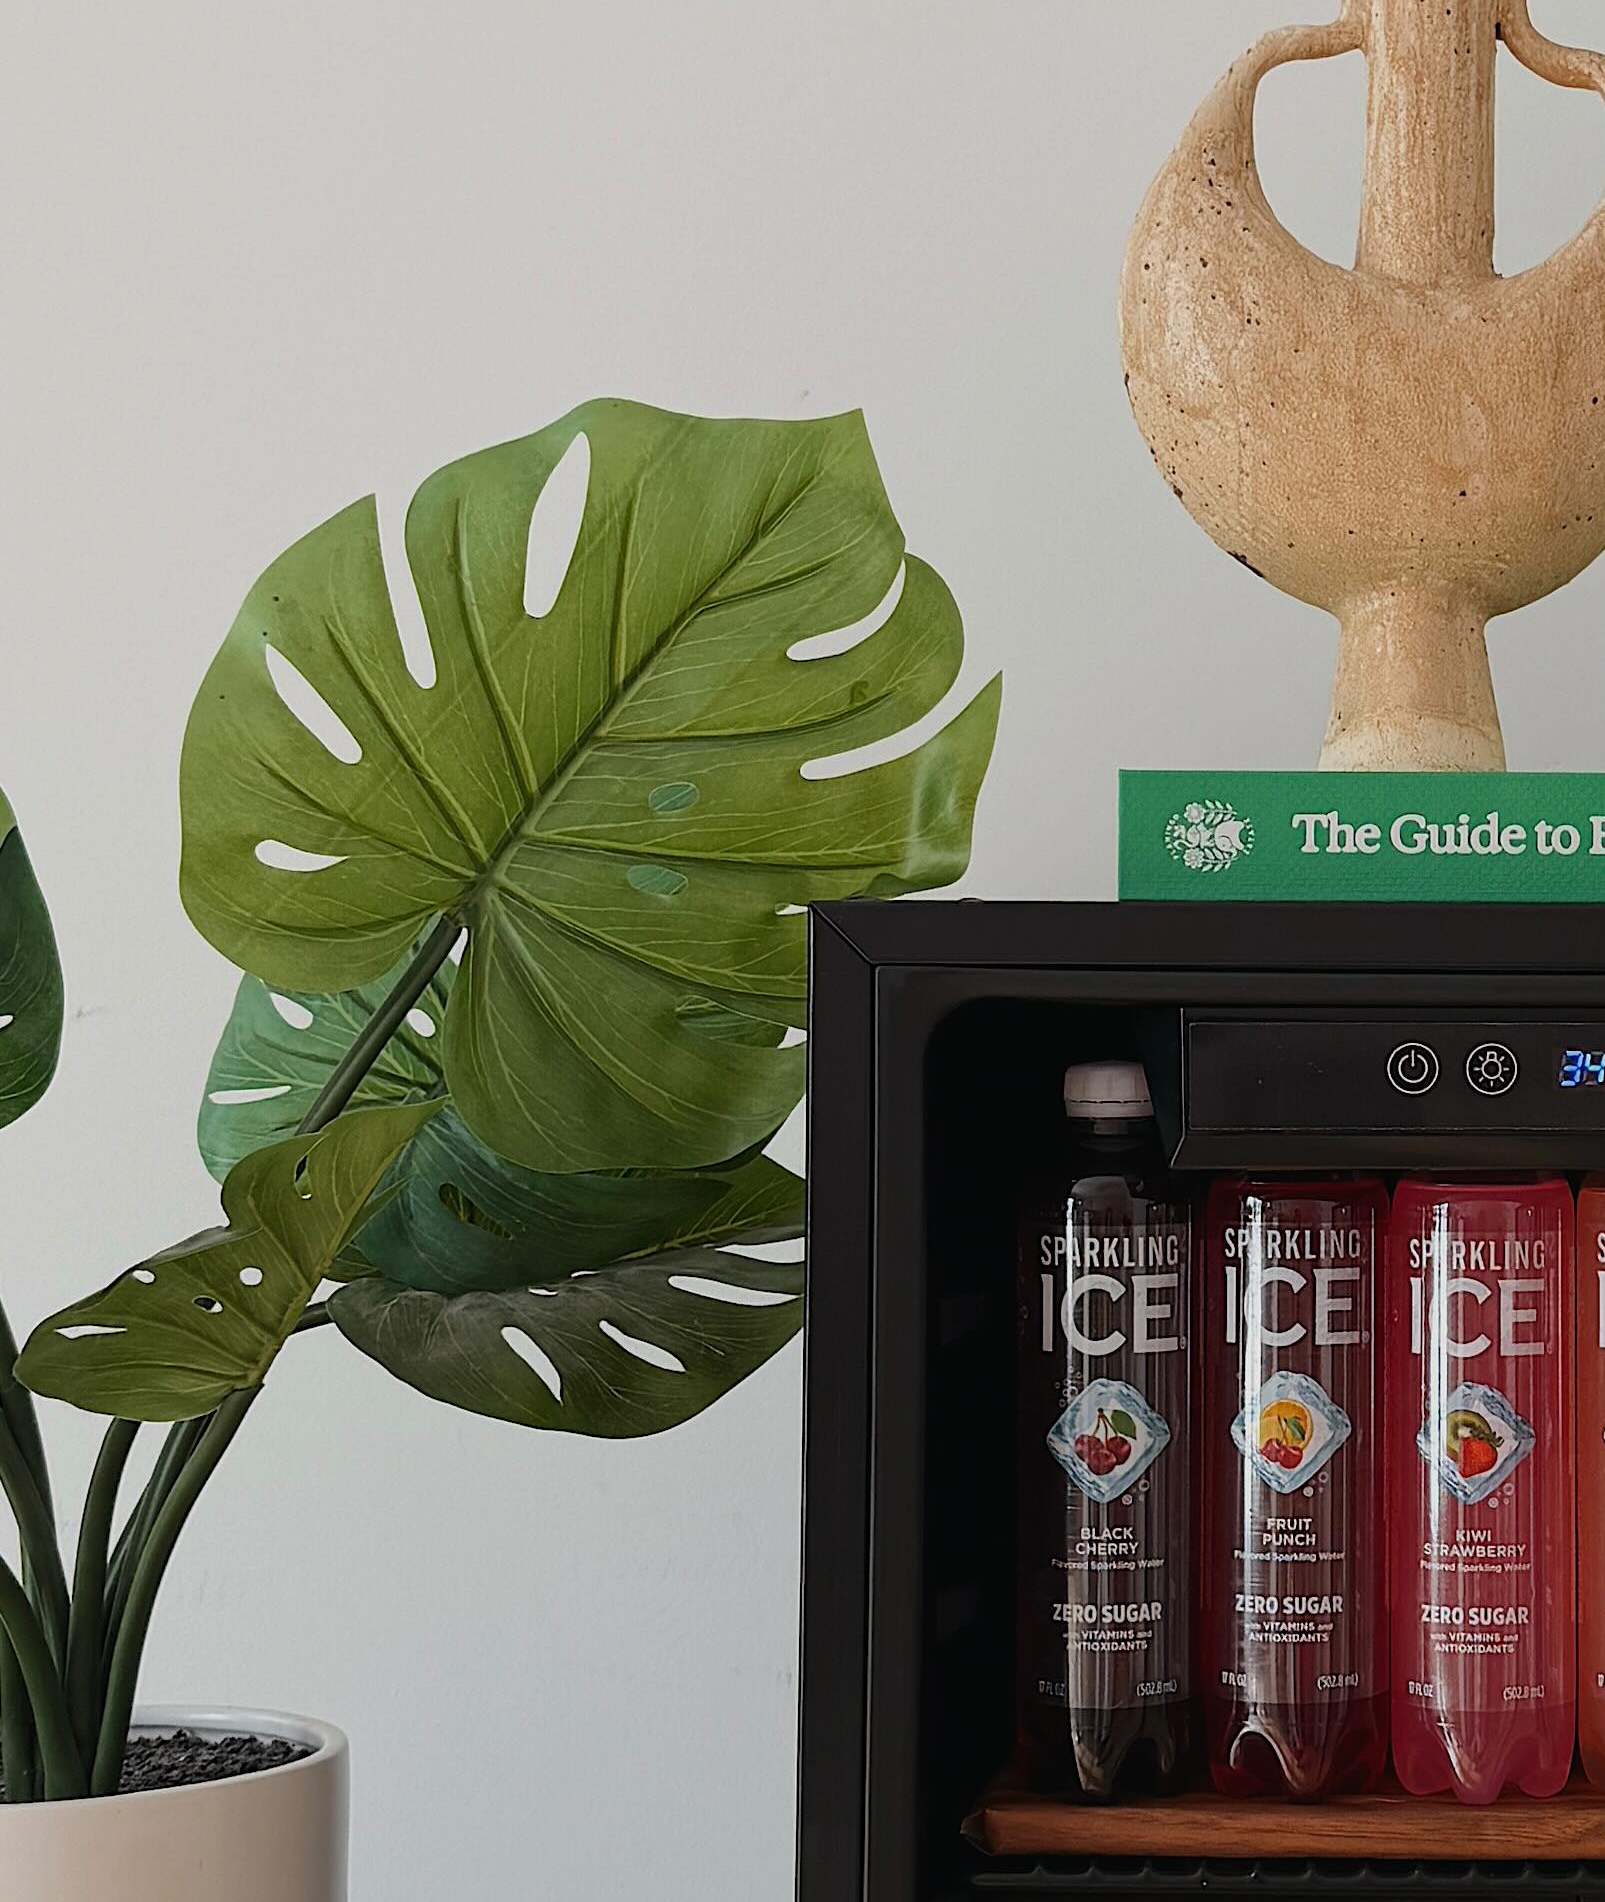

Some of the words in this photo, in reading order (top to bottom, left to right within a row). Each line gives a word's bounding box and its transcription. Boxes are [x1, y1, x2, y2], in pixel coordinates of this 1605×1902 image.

[1292, 811, 1381, 854] The
[1390, 812, 1526, 855] Guide
[1535, 820, 1581, 855] to
[1225, 1228, 1361, 1259] SPRKLING
[1041, 1235, 1178, 1267] SPARKLING
[1410, 1239, 1545, 1270] SPRKLING
[1225, 1266, 1360, 1346] ICE
[1041, 1273, 1178, 1356] ICE
[1410, 1277, 1544, 1357] ICE
[1267, 1518, 1312, 1530] FRUIT
[1081, 1527, 1133, 1540] BLACK
[1262, 1534, 1316, 1546] PUNCH
[1456, 1530, 1491, 1542] KIWI
[1075, 1542, 1139, 1555] CHERRY
[1424, 1543, 1526, 1557] STRAWBERRY
[1235, 1594, 1278, 1614] ZERO
[1283, 1596, 1343, 1614] SUGAR
[1053, 1604, 1097, 1623] ZERO
[1102, 1602, 1162, 1623] SUGAR
[1421, 1604, 1463, 1624] ZERO
[1469, 1606, 1529, 1625] SUGAR
[1263, 1622, 1315, 1631] VITAMINS
[1081, 1630, 1134, 1639] VITAMINS
[1250, 1633, 1329, 1642] ANTIOXIDANTS
[1449, 1633, 1500, 1642] VITAMINS
[1067, 1640, 1147, 1650] ANTIOXIDANTS
[1435, 1644, 1514, 1653] ANTIOXIDANTS
